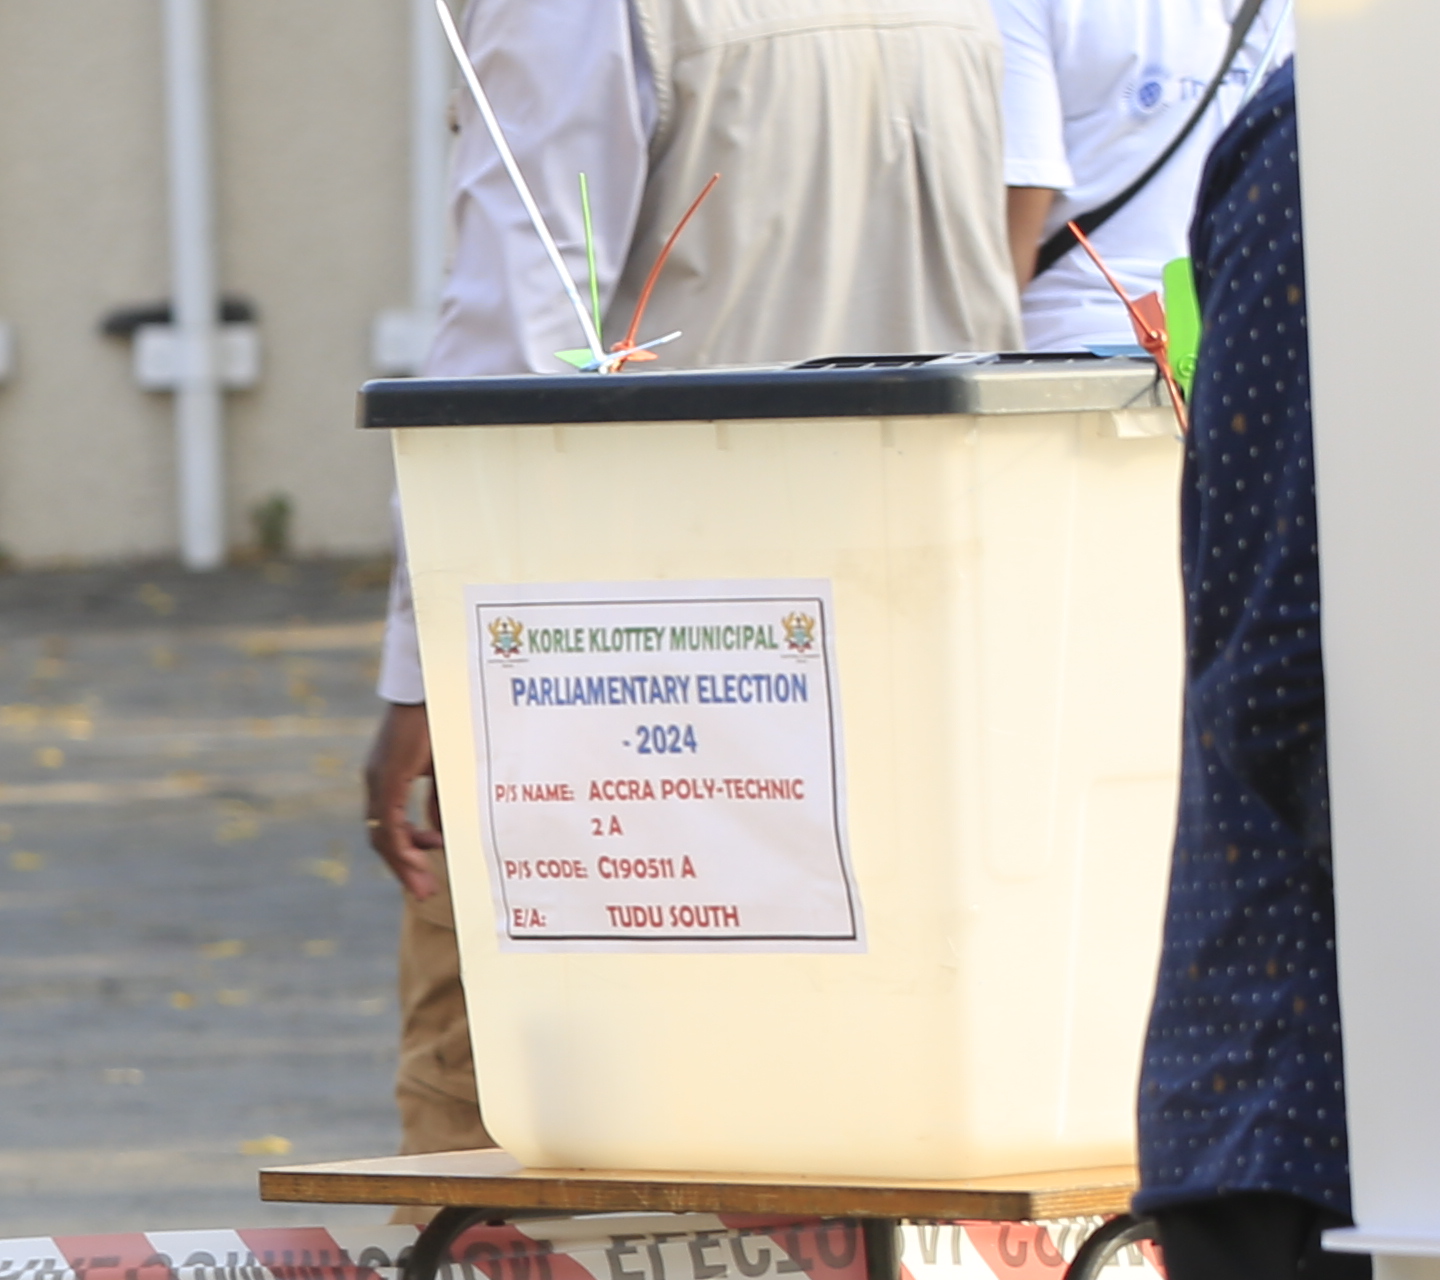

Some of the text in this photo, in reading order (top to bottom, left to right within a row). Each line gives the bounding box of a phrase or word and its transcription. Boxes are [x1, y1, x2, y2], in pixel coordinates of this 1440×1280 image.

[528, 624, 779, 653] KORLE KLOTTEY MUNICIPAL
[511, 673, 808, 706] PARLIAMENTARY ELECTION
[636, 725, 697, 754] 2024
[495, 779, 804, 803] P/S NAME: ACCRA POLY-TECHNIC
[592, 815, 623, 836] 2 A
[505, 856, 696, 880] P/S CODE: C190511 A
[513, 905, 739, 929] E/A: TUDU SOUTH
